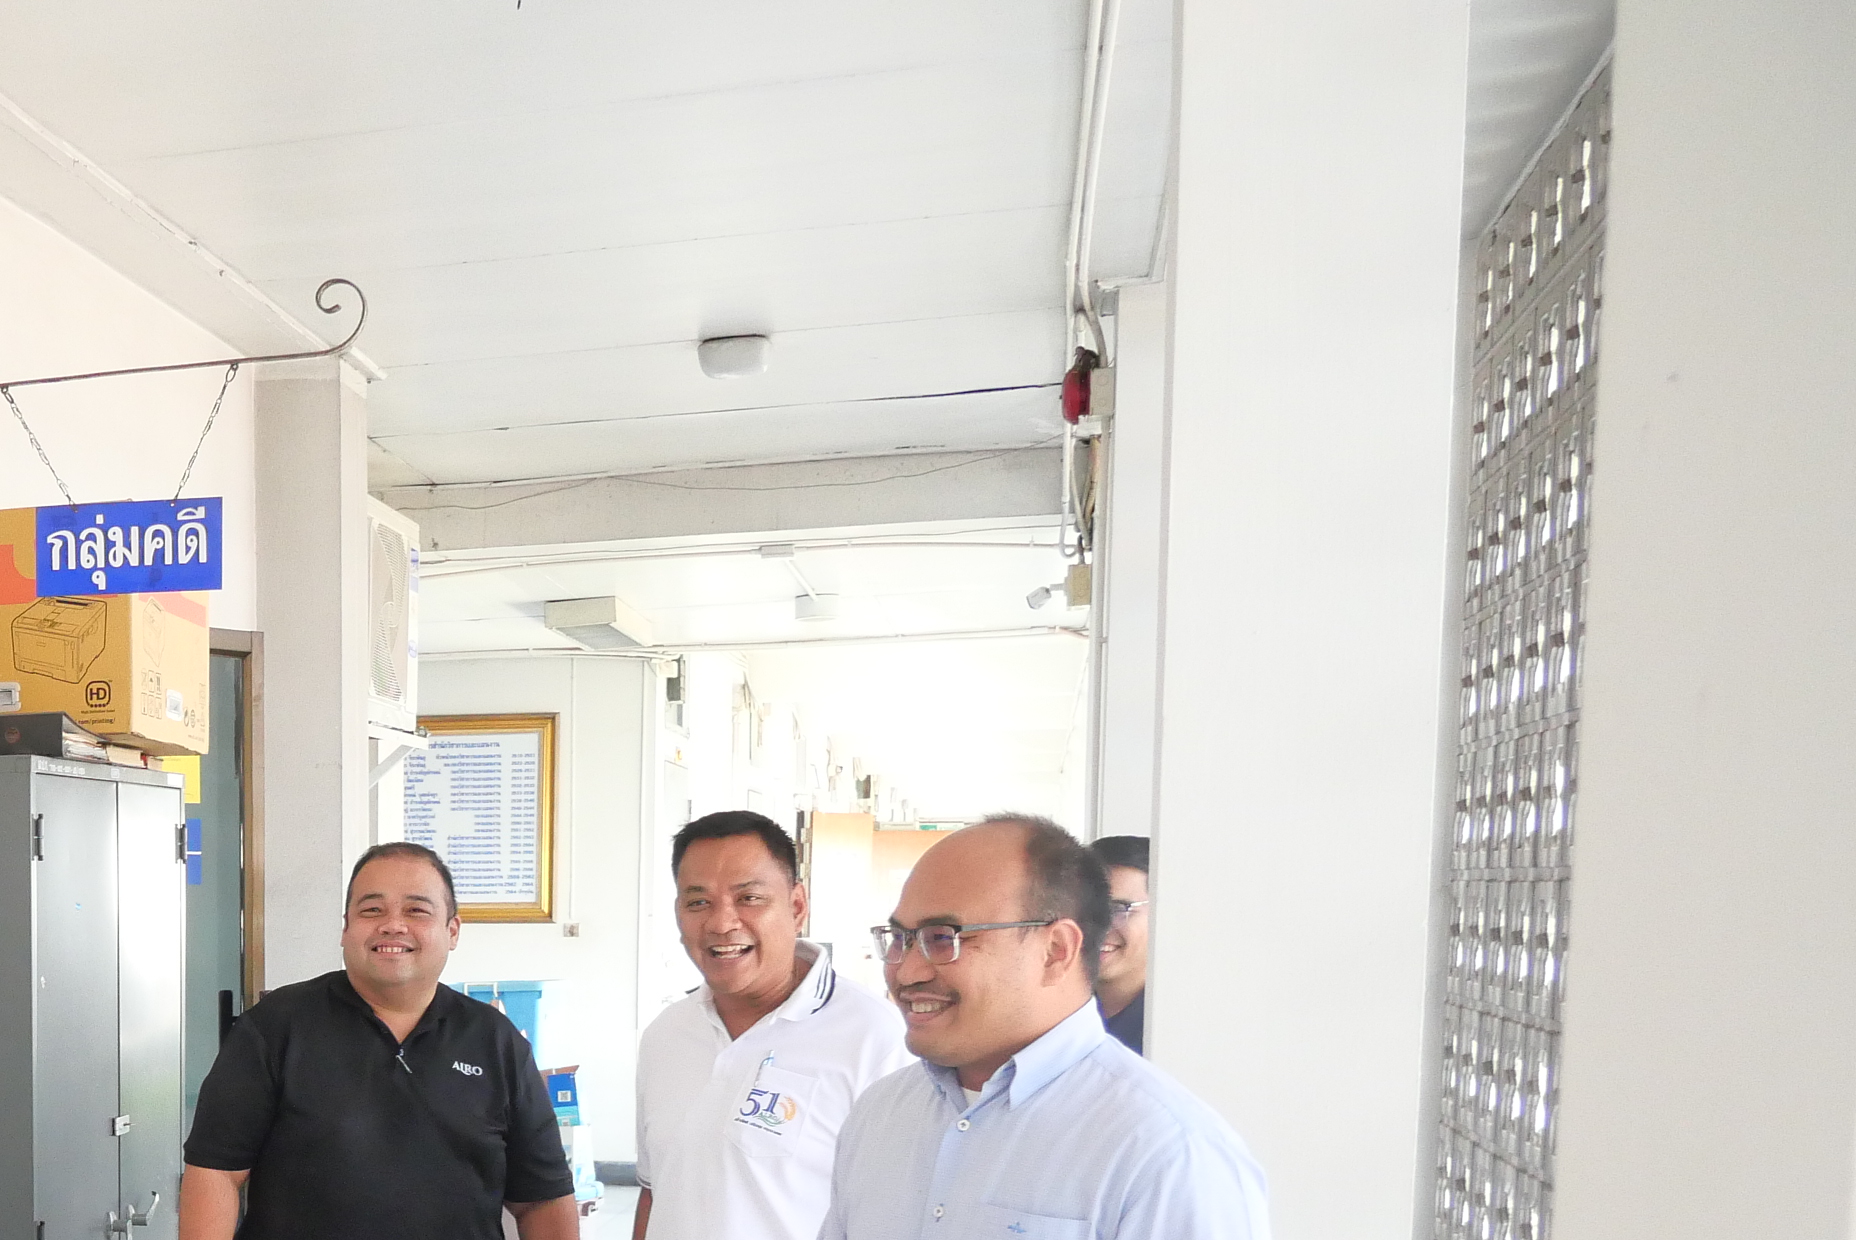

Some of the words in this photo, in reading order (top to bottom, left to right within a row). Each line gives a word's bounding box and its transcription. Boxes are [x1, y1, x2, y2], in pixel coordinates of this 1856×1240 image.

[46, 506, 208, 590] กลุ่มคดี
[89, 687, 107, 701] HD
[740, 1089, 780, 1116] 51
